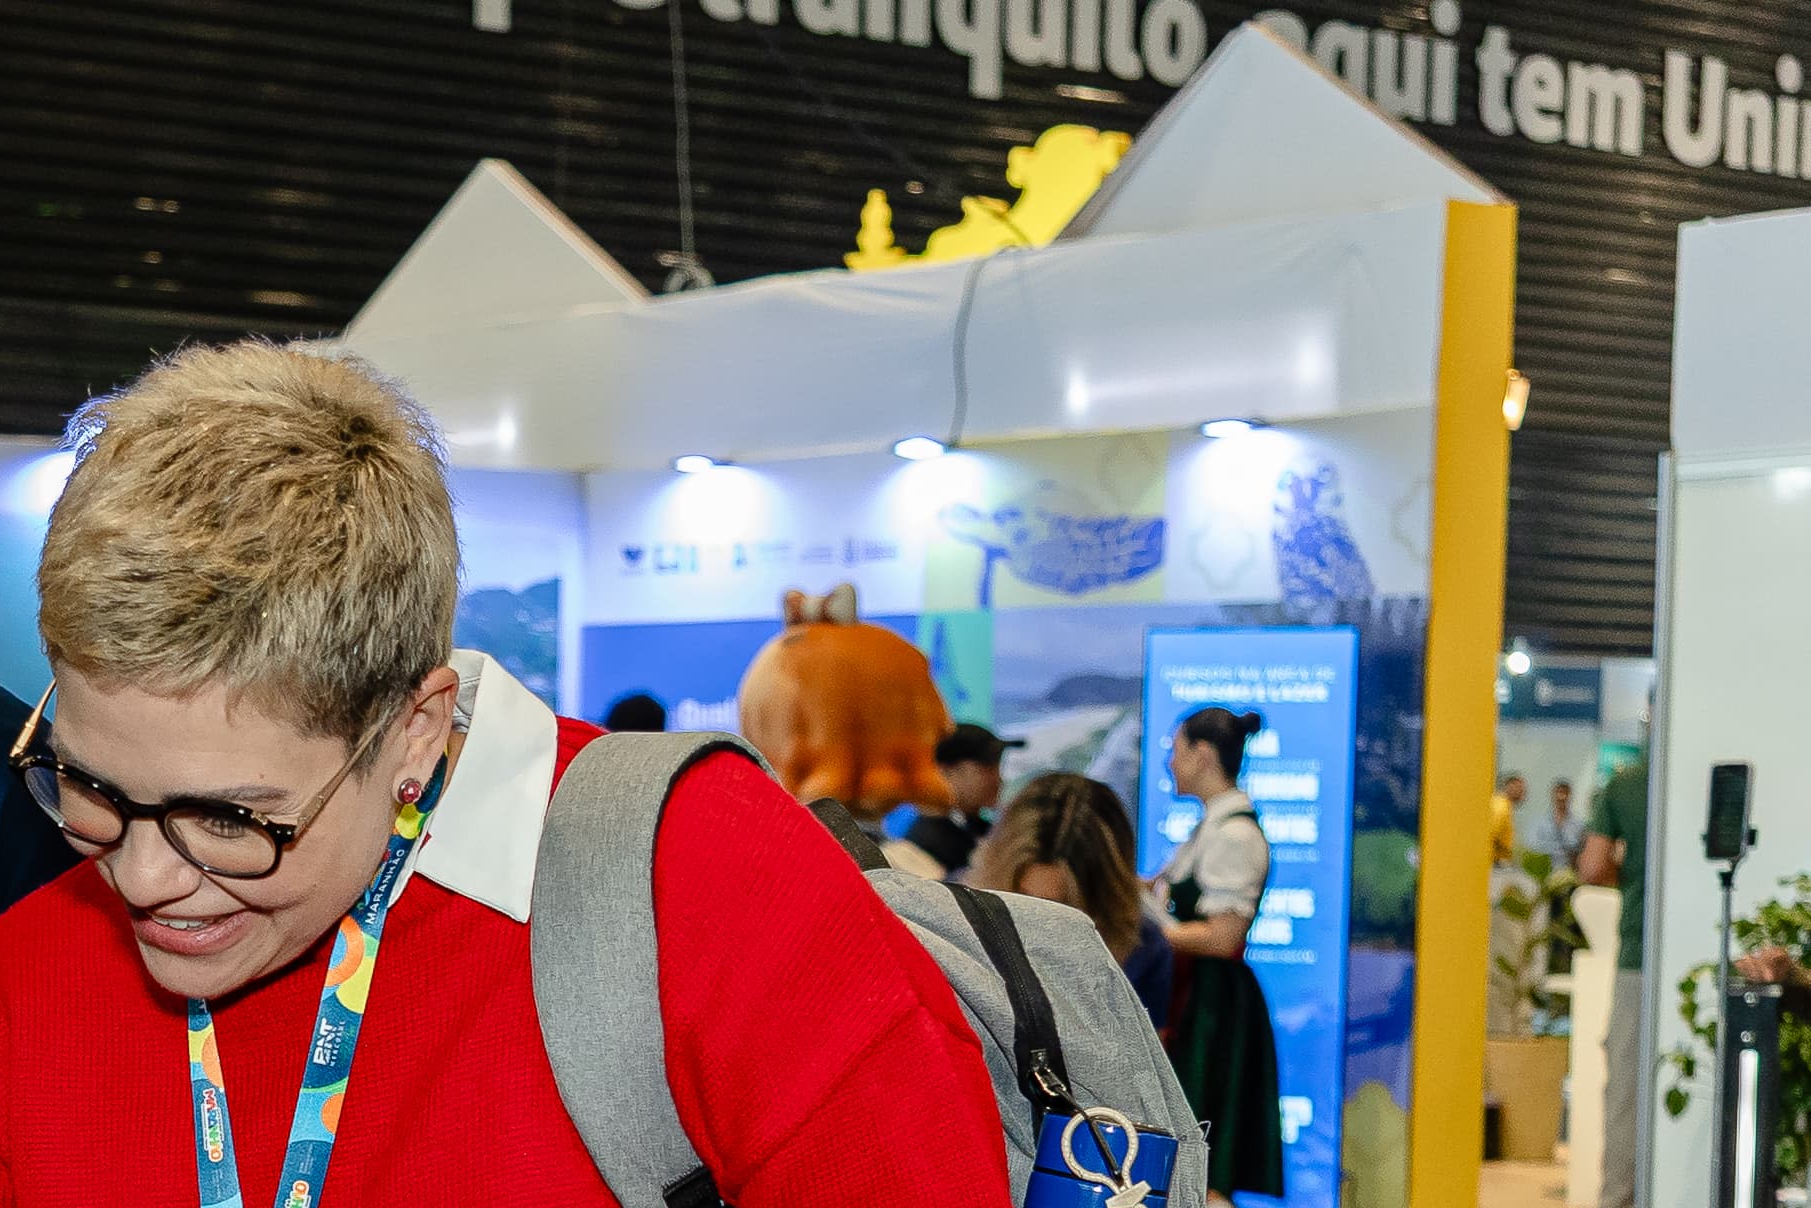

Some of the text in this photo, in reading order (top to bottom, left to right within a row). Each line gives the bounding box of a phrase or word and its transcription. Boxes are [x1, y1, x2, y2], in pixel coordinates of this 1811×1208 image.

[1475, 25, 1646, 157] tem
[365, 849, 405, 925] MARANHÃO
[312, 1017, 337, 1066] BNT
